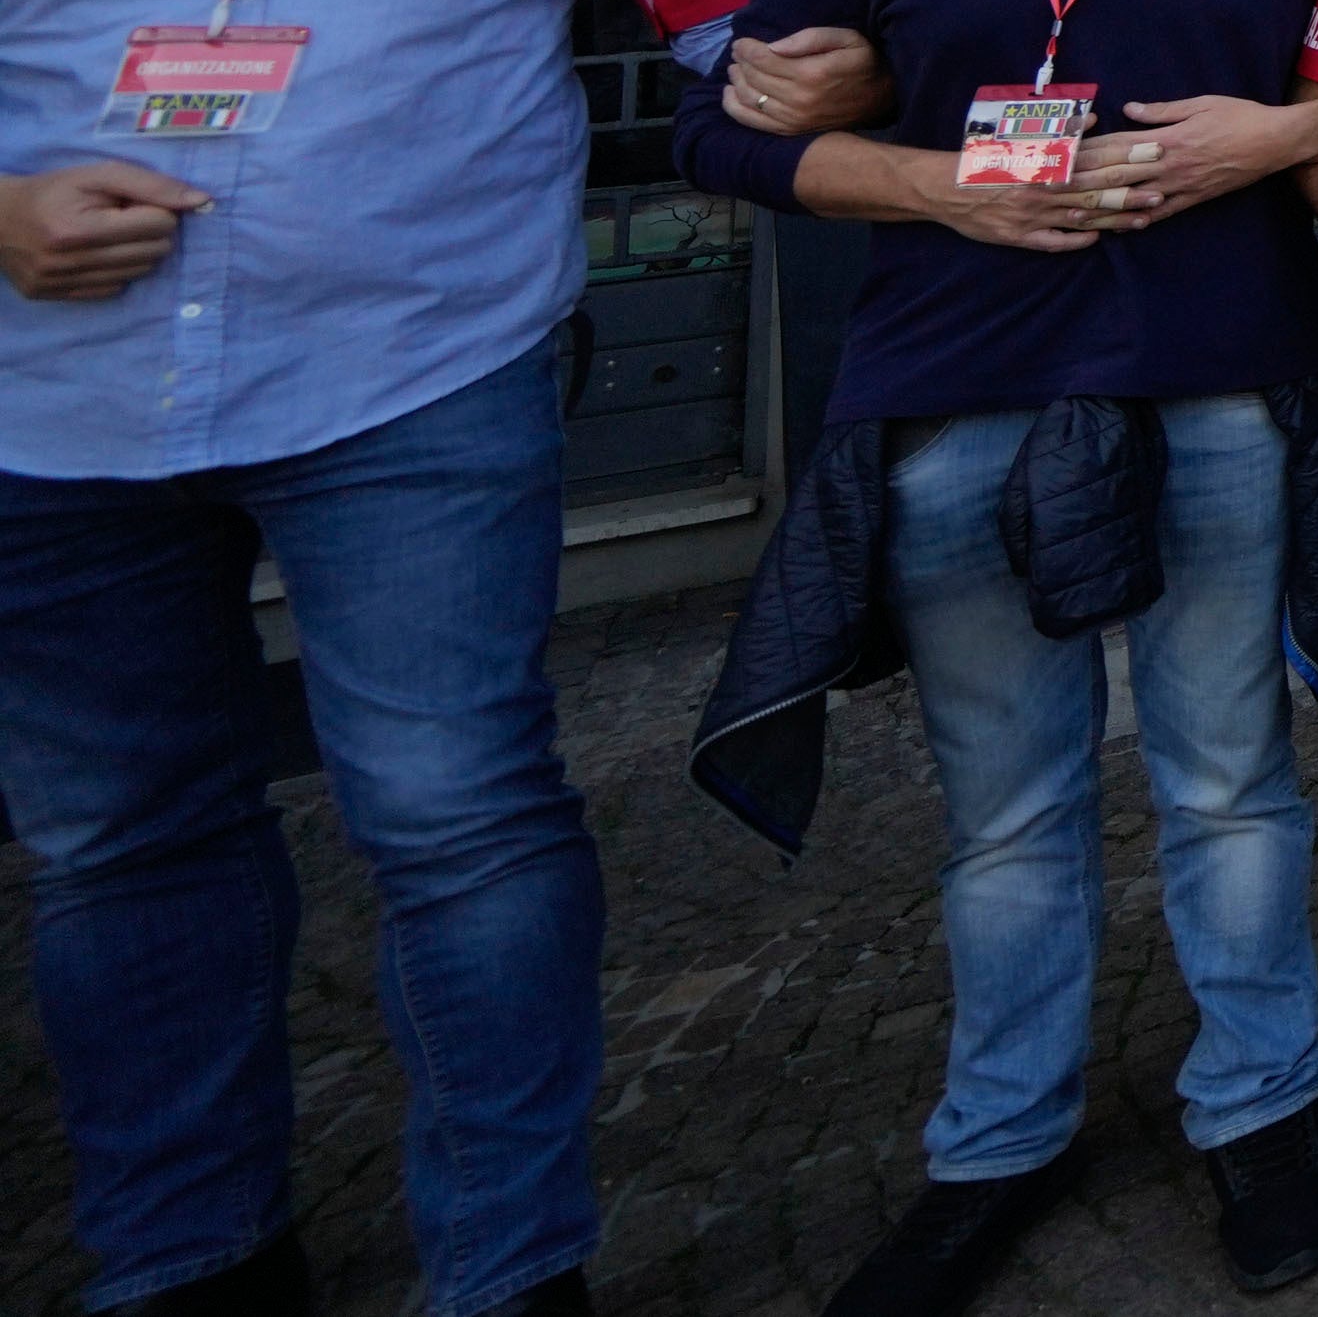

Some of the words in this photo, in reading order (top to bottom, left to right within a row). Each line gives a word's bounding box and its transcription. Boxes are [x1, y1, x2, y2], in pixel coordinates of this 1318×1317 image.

[135, 60, 276, 77] ORGANIZZAZIONE
[1016, 103, 1068, 118] A.N.P.I.
[971, 153, 1062, 170] ORGANIZZAZIONE
